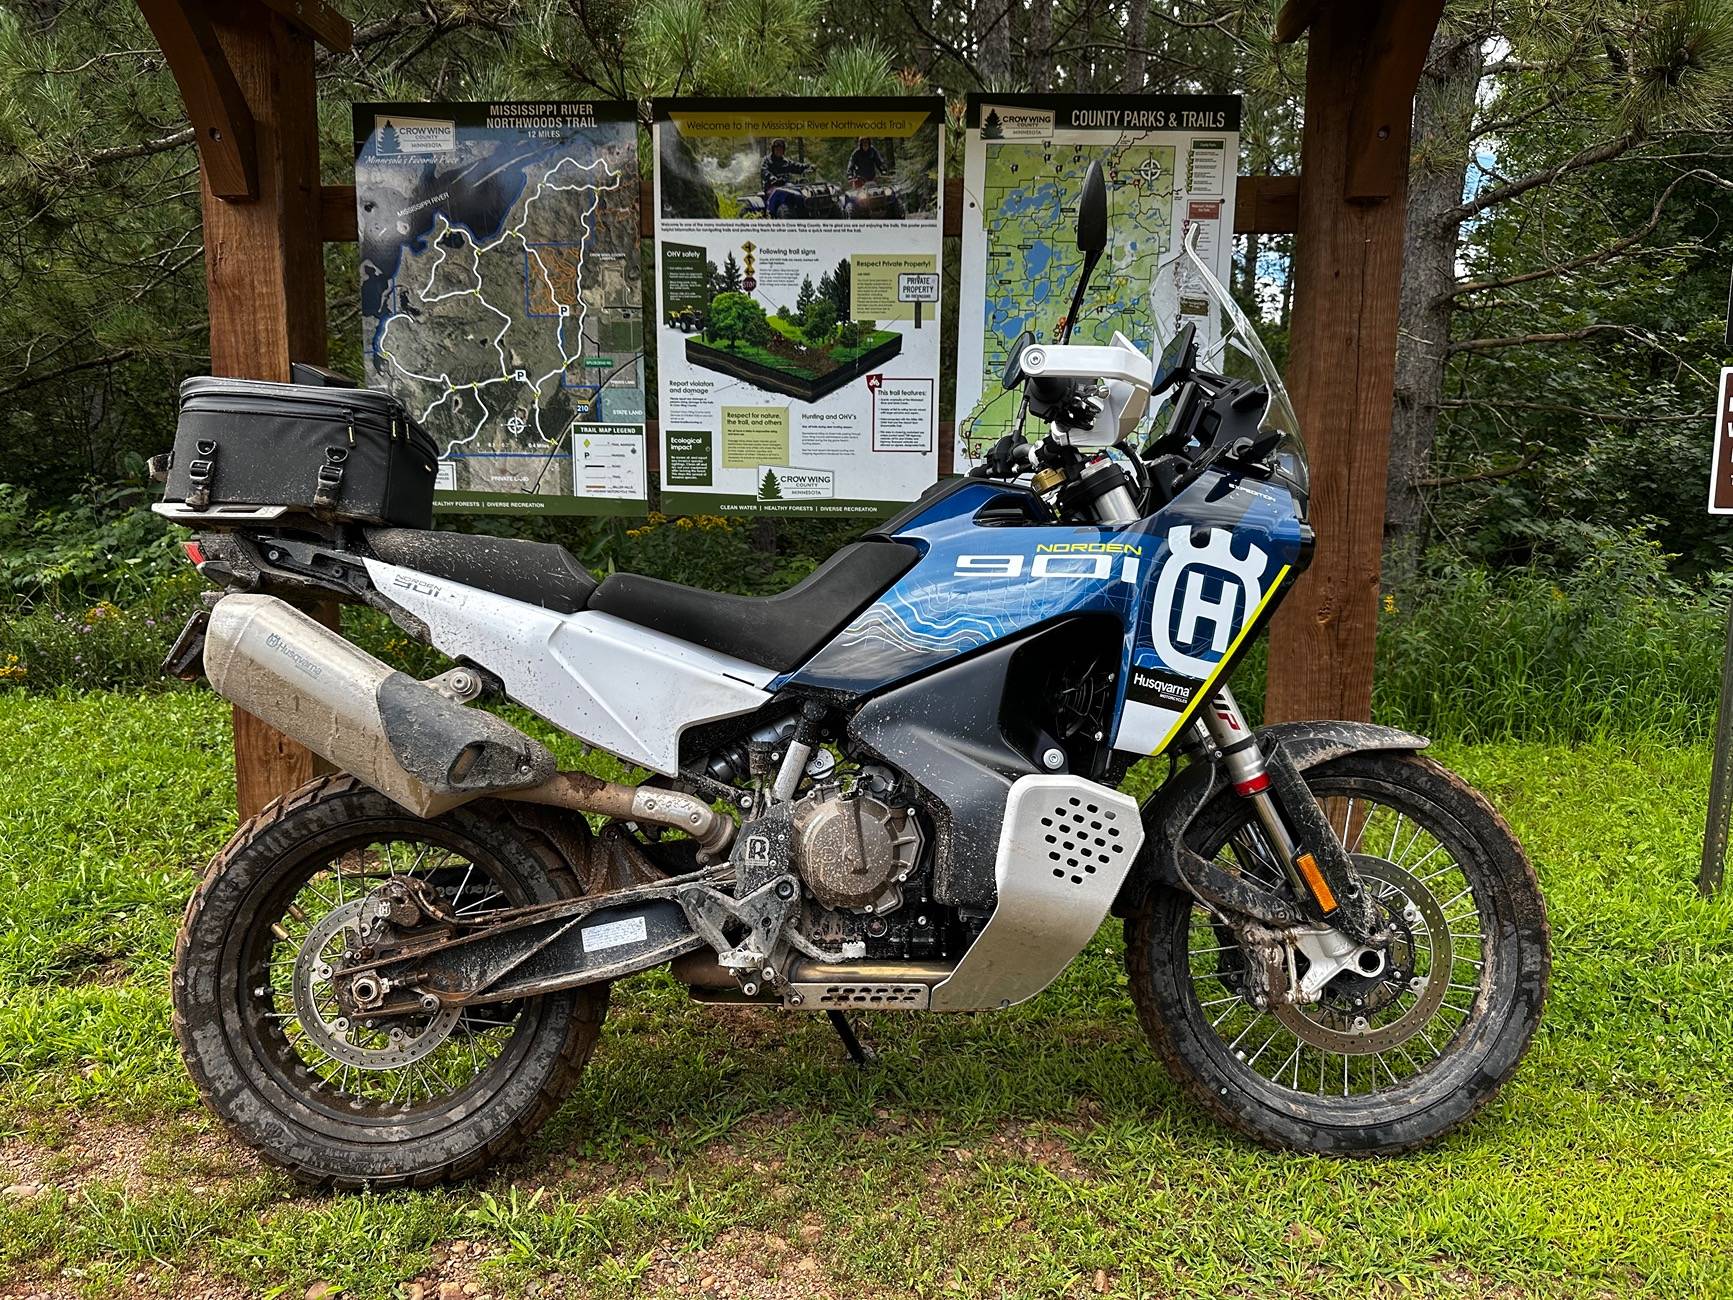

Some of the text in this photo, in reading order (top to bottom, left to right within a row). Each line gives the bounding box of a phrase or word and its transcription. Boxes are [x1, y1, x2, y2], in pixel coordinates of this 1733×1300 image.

[490, 104, 593, 116] MISSISSIPPI RIVER
[486, 116, 598, 128] NORTHWOODS TRAIL
[1072, 110, 1225, 128] COUNTY PARKS & TRAILS
[687, 120, 906, 131] Welcome to the Mississippi River Northwoods Trail
[527, 130, 560, 138] 12 MILES
[396, 191, 450, 217] MISSISSIPPI RIVER
[666, 250, 701, 259] OHV safety
[759, 248, 787, 256] Following
[801, 248, 816, 256] signs
[856, 260, 882, 268] Respect
[882, 260, 903, 268] Private
[906, 277, 931, 285] PRIVATE
[902, 286, 934, 294] PROPERTY
[560, 306, 568, 314] P
[517, 371, 525, 380] P
[669, 380, 689, 388] Report
[682, 387, 709, 395] damage
[801, 413, 825, 421] Hunting
[670, 436, 703, 445] Ecological
[780, 475, 807, 483] CROW
[1036, 543, 1142, 556] NORDEN
[953, 554, 1140, 584] 901
[395, 574, 442, 592] NORDEN
[276, 641, 322, 676] Husqvarna
[1133, 672, 1191, 698] Husqvarna
[1159, 693, 1188, 704] MOTORCYCLES
